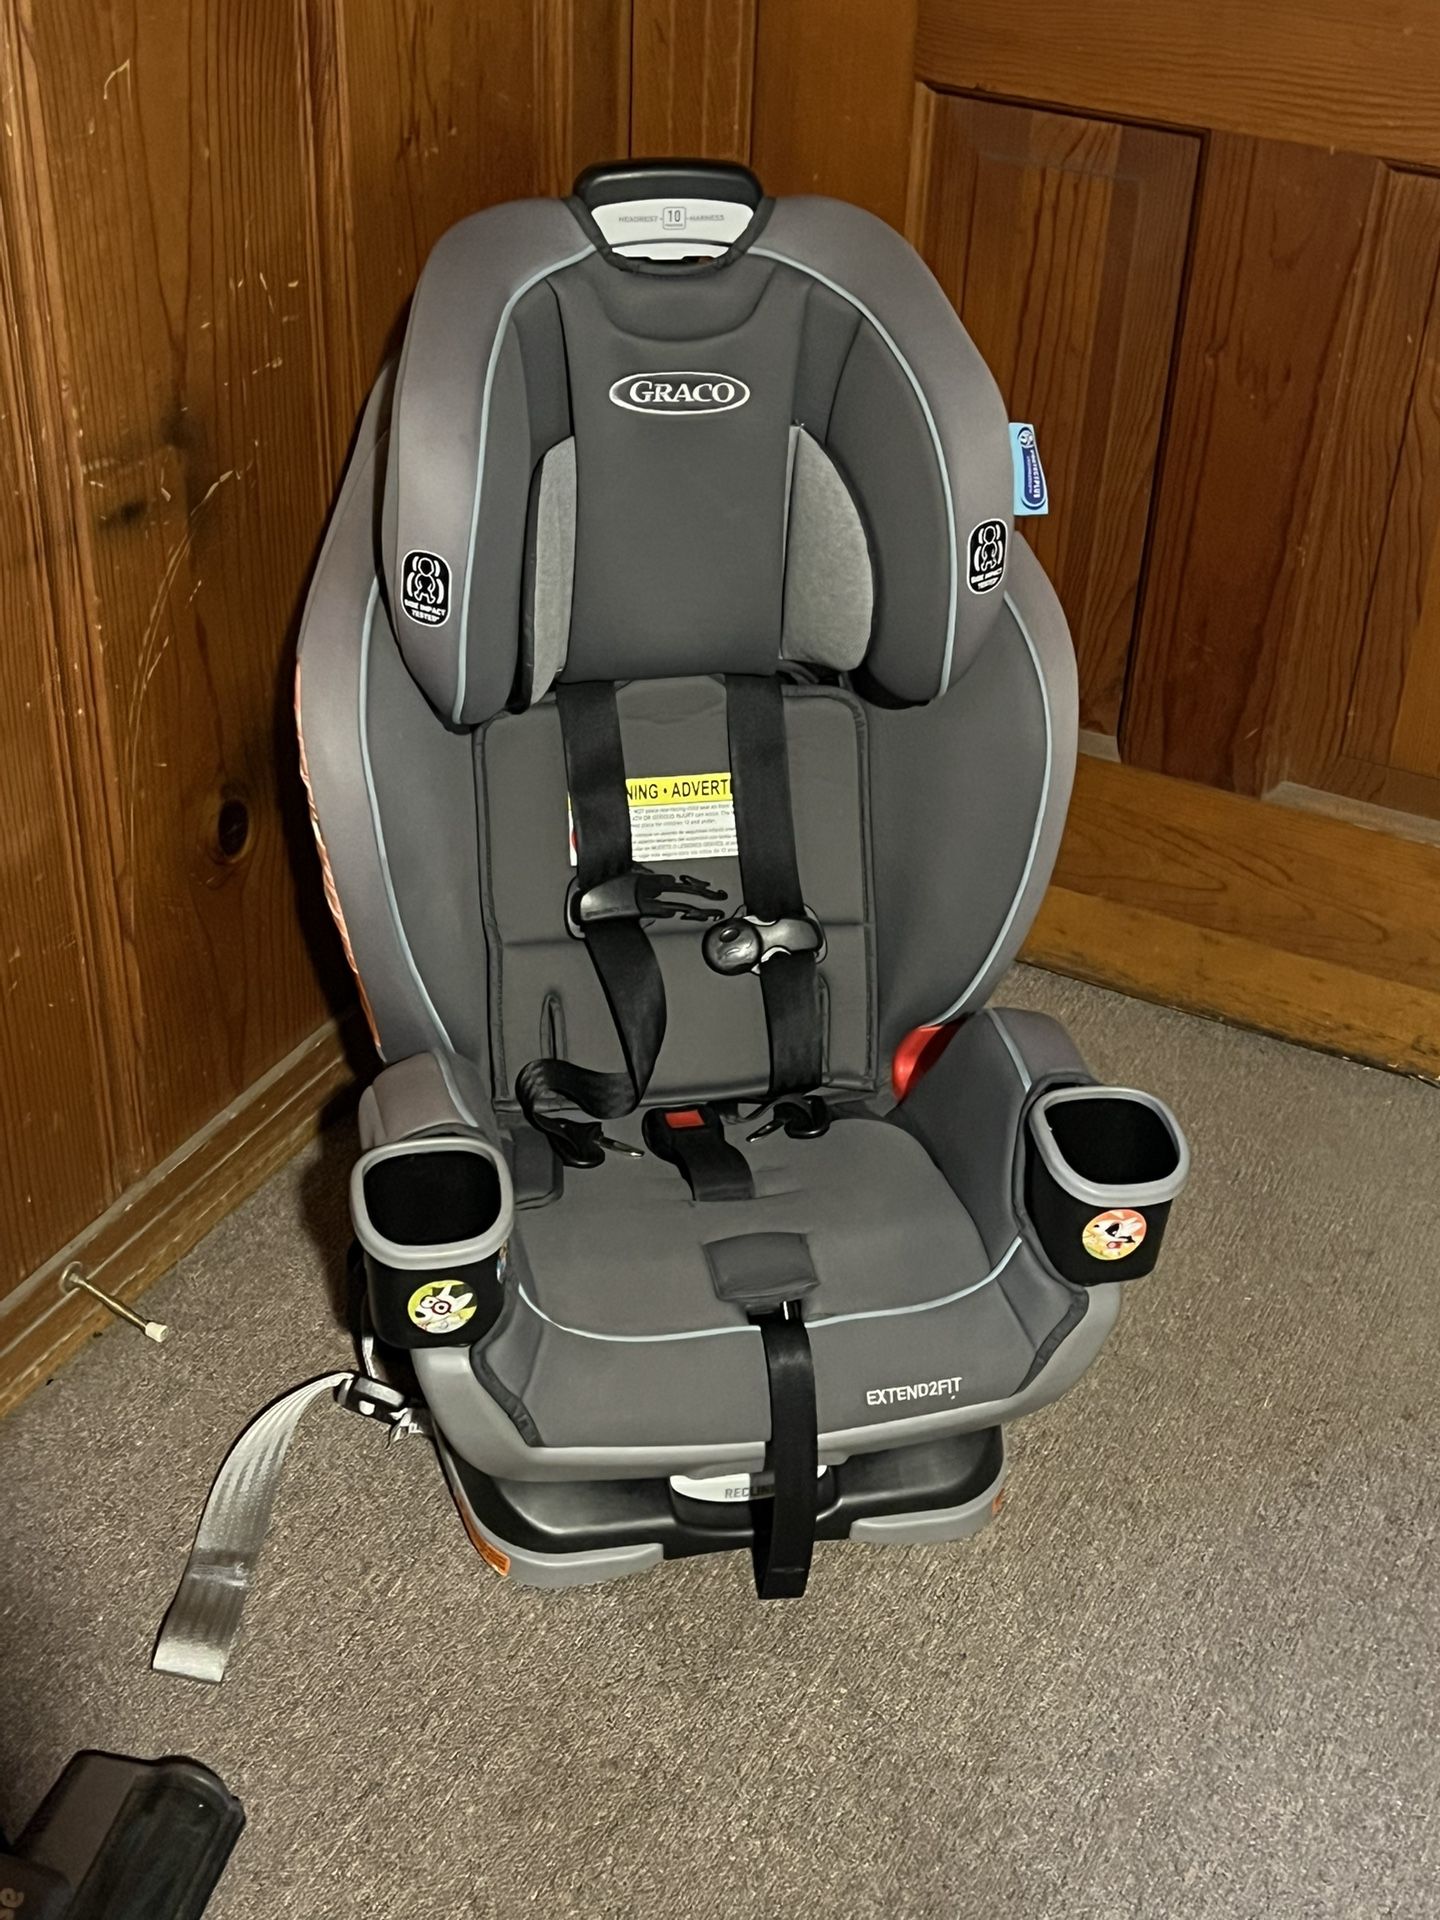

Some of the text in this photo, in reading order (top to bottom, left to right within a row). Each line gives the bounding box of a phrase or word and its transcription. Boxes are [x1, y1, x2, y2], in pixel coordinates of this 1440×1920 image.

[668, 210, 681, 222] 10
[629, 380, 735, 403] GRACO
[671, 778, 730, 798] ADVERT
[866, 1376, 963, 1405] EXTEND2FIT
